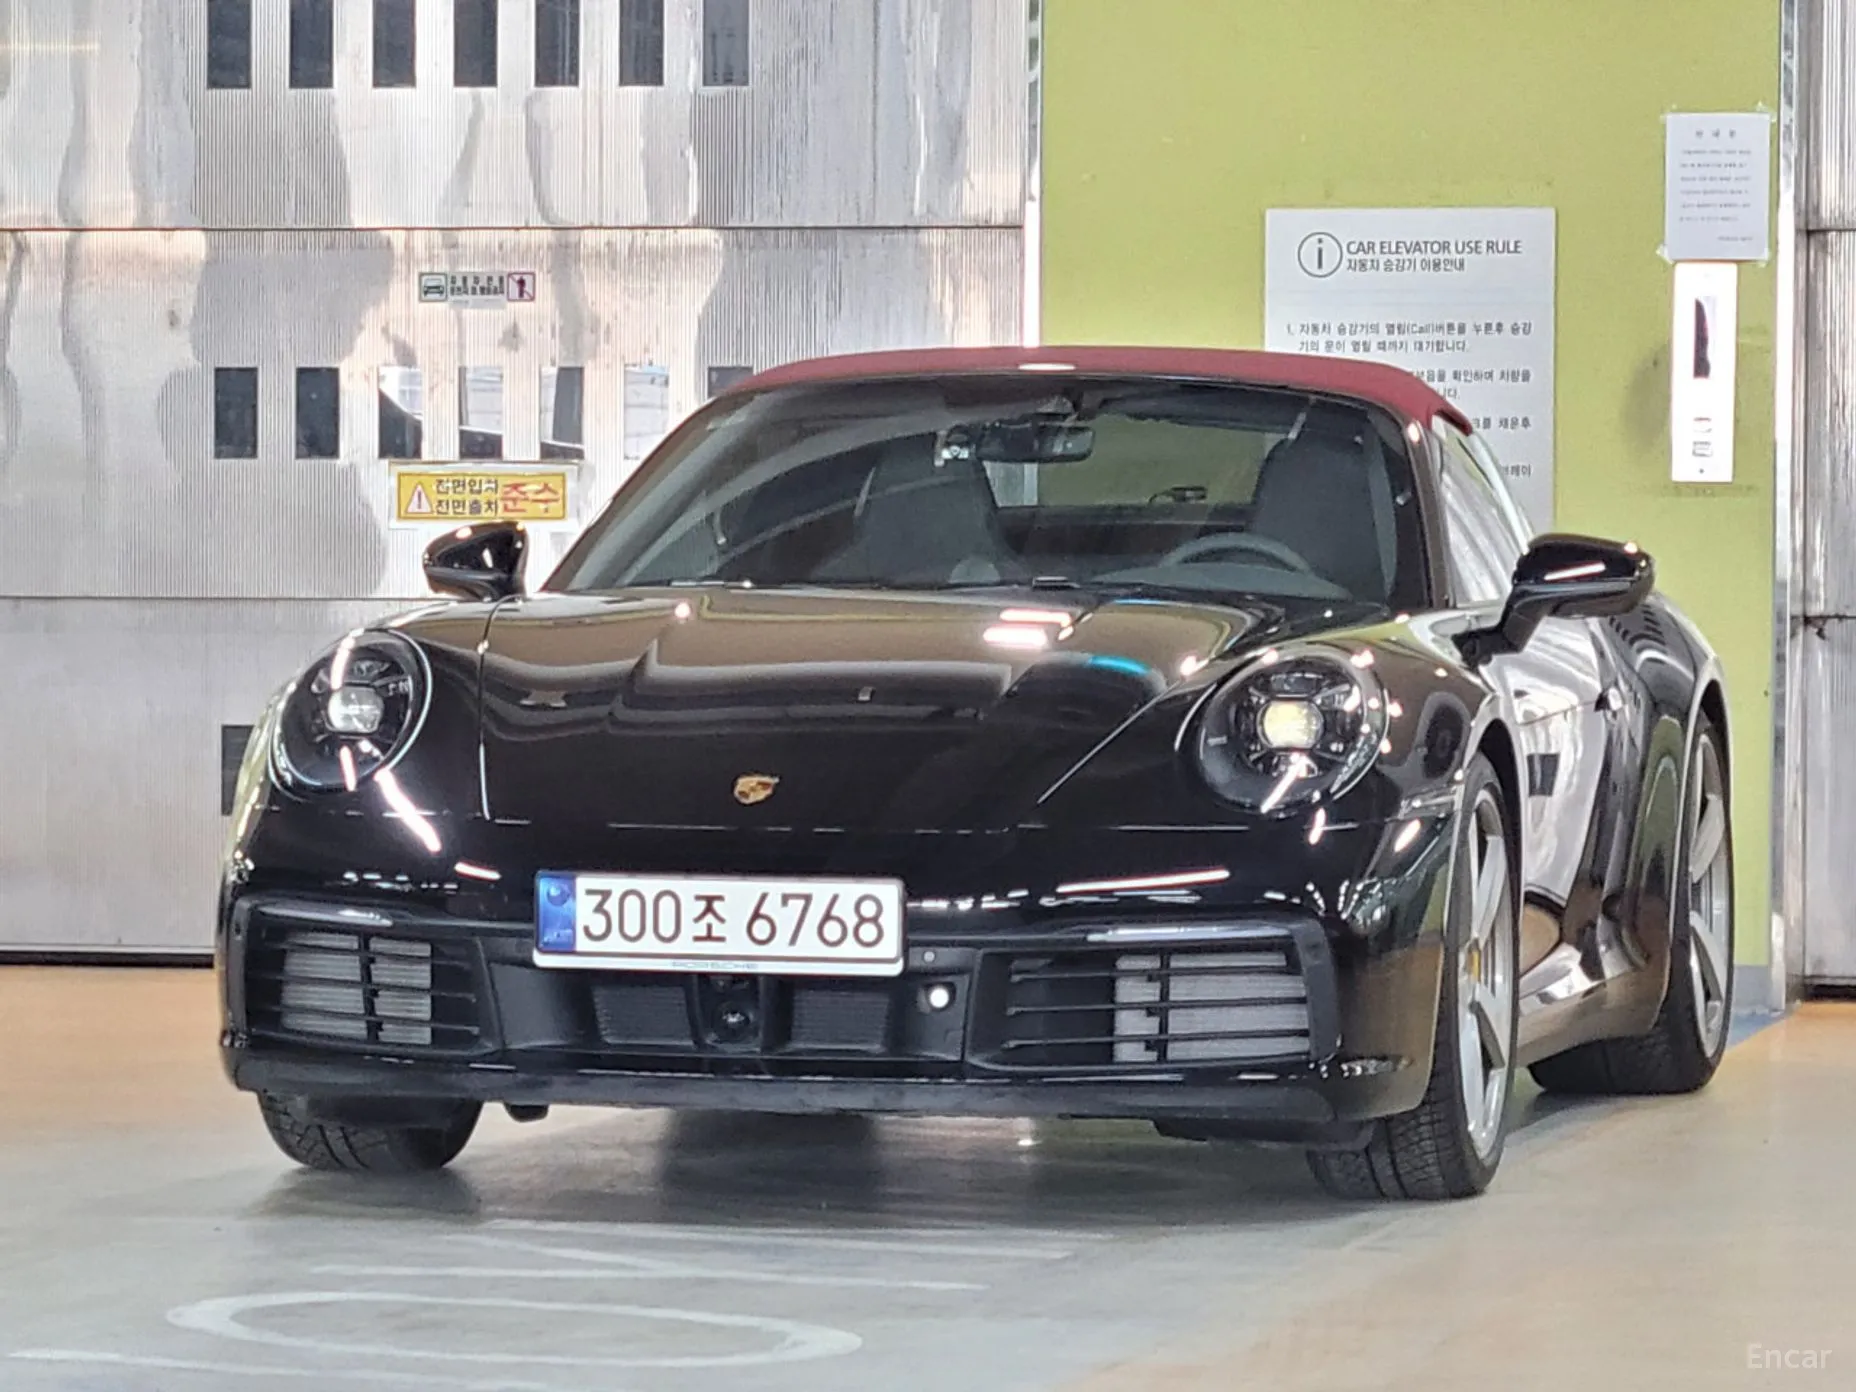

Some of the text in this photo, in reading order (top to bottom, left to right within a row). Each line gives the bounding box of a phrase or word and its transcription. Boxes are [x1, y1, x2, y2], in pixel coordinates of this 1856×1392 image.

[1346, 239, 1522, 255] CAR ELEVATOR USE RULE
[1346, 257, 1465, 272] 자동차 승강기 이용안내
[1299, 321, 1332, 336] 자동차
[1337, 321, 1380, 336] 승강기의
[1473, 321, 1504, 336] 누른후
[1510, 321, 1532, 336] 승강
[1299, 339, 1320, 354] 기의
[1376, 339, 1409, 353] 때까지
[1413, 338, 1470, 354] 대기합니다.
[435, 478, 499, 495] 전면입차
[502, 481, 561, 515] 준수
[435, 499, 499, 517] 전면출차
[582, 888, 885, 949] 300조 6768
